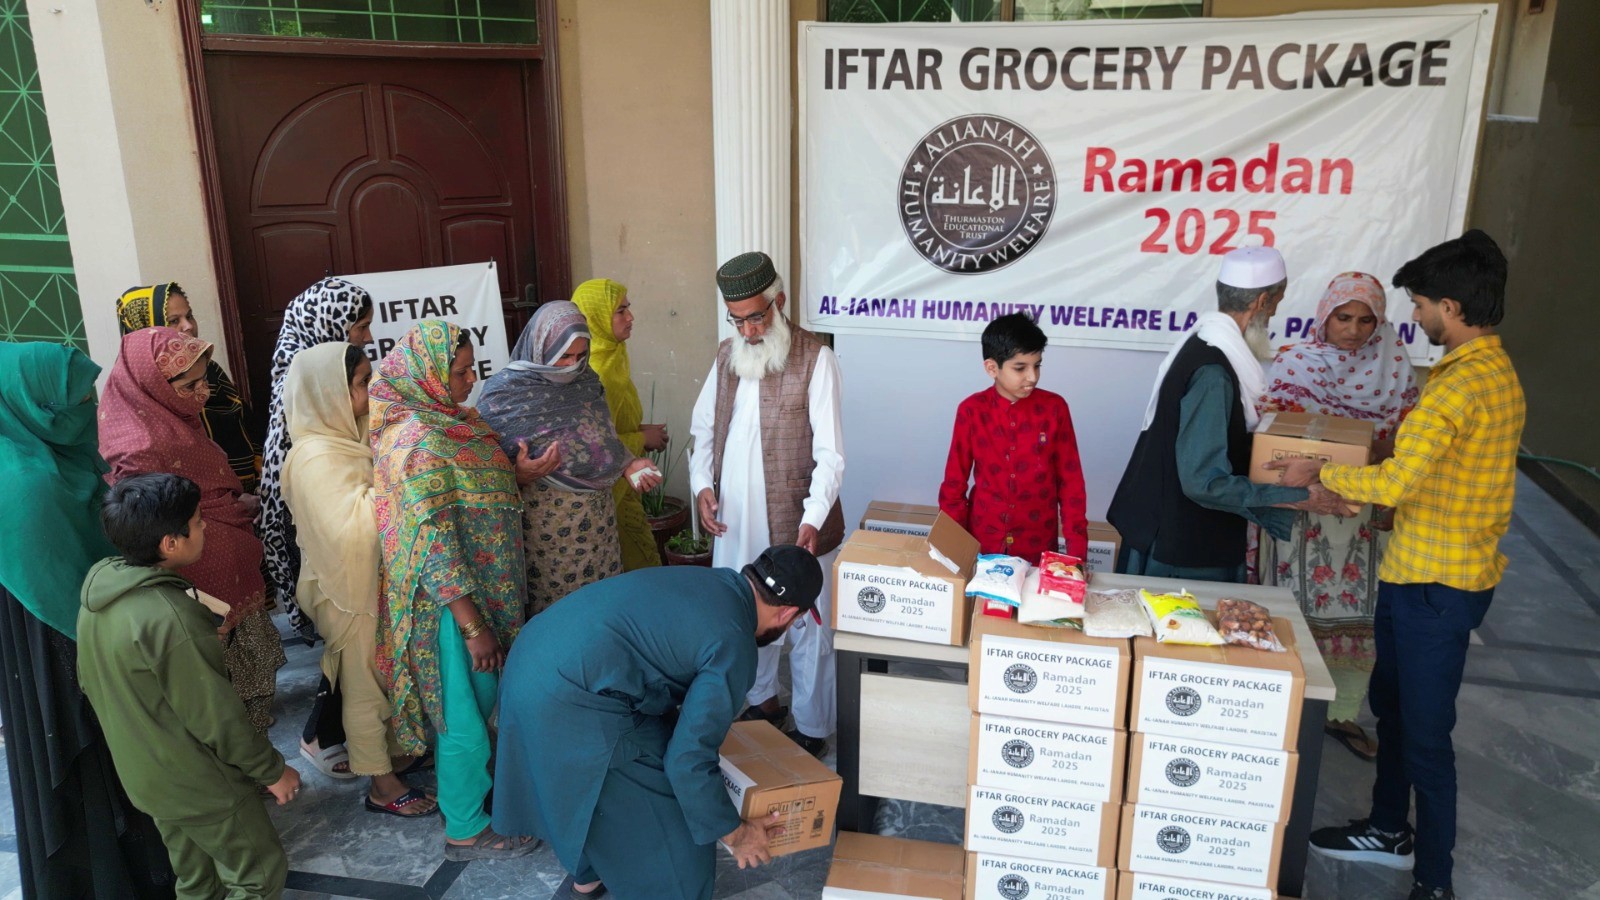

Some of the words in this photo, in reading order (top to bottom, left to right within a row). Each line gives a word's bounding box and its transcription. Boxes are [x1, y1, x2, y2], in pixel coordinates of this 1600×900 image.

[824, 48, 943, 91] IFTAR
[959, 46, 1187, 91] GROCERY
[1201, 40, 1451, 90] PACKAGE
[925, 119, 1037, 161] ALIANAH
[1083, 143, 1354, 195] Ramadan
[904, 179, 985, 270] HUMANITY
[987, 179, 1051, 265] WELFARE
[943, 222, 1005, 232] EDUCATIONAL
[944, 214, 1006, 224] THURMASTON
[959, 231, 988, 240] TRUST
[1140, 207, 1277, 255] 2025
[379, 295, 459, 324] IFTAR
[819, 295, 916, 319] AL-IANAH
[1050, 304, 1162, 331] WELFARE
[843, 572, 866, 582] IFTAR
[868, 575, 907, 587] GROCERY
[909, 580, 948, 592] PACKAGE
[890, 594, 935, 607] Ramadan
[900, 605, 924, 616] 2025
[987, 648, 1014, 658] IFTAR
[1016, 651, 1063, 664] GROCERY
[1065, 656, 1112, 669] PACKAGE
[1042, 671, 1096, 686] Ramadan
[1149, 670, 1177, 681] IFTAR
[1180, 673, 1230, 687] GROCERY
[1232, 679, 1282, 693] PACKAGE
[1055, 684, 1082, 695] 2025
[1207, 694, 1264, 710] Ramadan
[1220, 707, 1249, 719] 2025
[985, 723, 1011, 735] IFTAR
[1014, 727, 1060, 740] GROCERY
[1062, 732, 1108, 745] PACKAGE
[1040, 747, 1092, 762] Ramadan
[1149, 741, 1177, 753] IFTAR
[1180, 745, 1228, 759] GROCERY
[1231, 751, 1280, 766] PACKAGE
[1051, 759, 1078, 771] 2025
[1206, 766, 1262, 782] Ramadan
[720, 774, 741, 796] ACKAGE
[1218, 779, 1247, 791] 2025
[976, 790, 1002, 801] IFTAR
[1005, 793, 1049, 807] GROCERY
[1051, 799, 1096, 812] PACKAGE
[1029, 813, 1081, 828] Ramadan
[1140, 810, 1168, 821] IFTAR
[1170, 813, 1218, 827] GROCERY
[1220, 819, 1268, 833] PACKAGE
[1041, 825, 1067, 837] 2025
[1196, 833, 1250, 848] Ramadan
[1208, 846, 1236, 857] 2025
[982, 859, 1007, 869] IFTAR
[1009, 862, 1054, 875] GROCERY
[1056, 867, 1100, 880] PACKAGE
[1034, 881, 1085, 896] Ramadan
[1139, 882, 1166, 893] IFTAR
[1168, 886, 1215, 900] GROCERY
